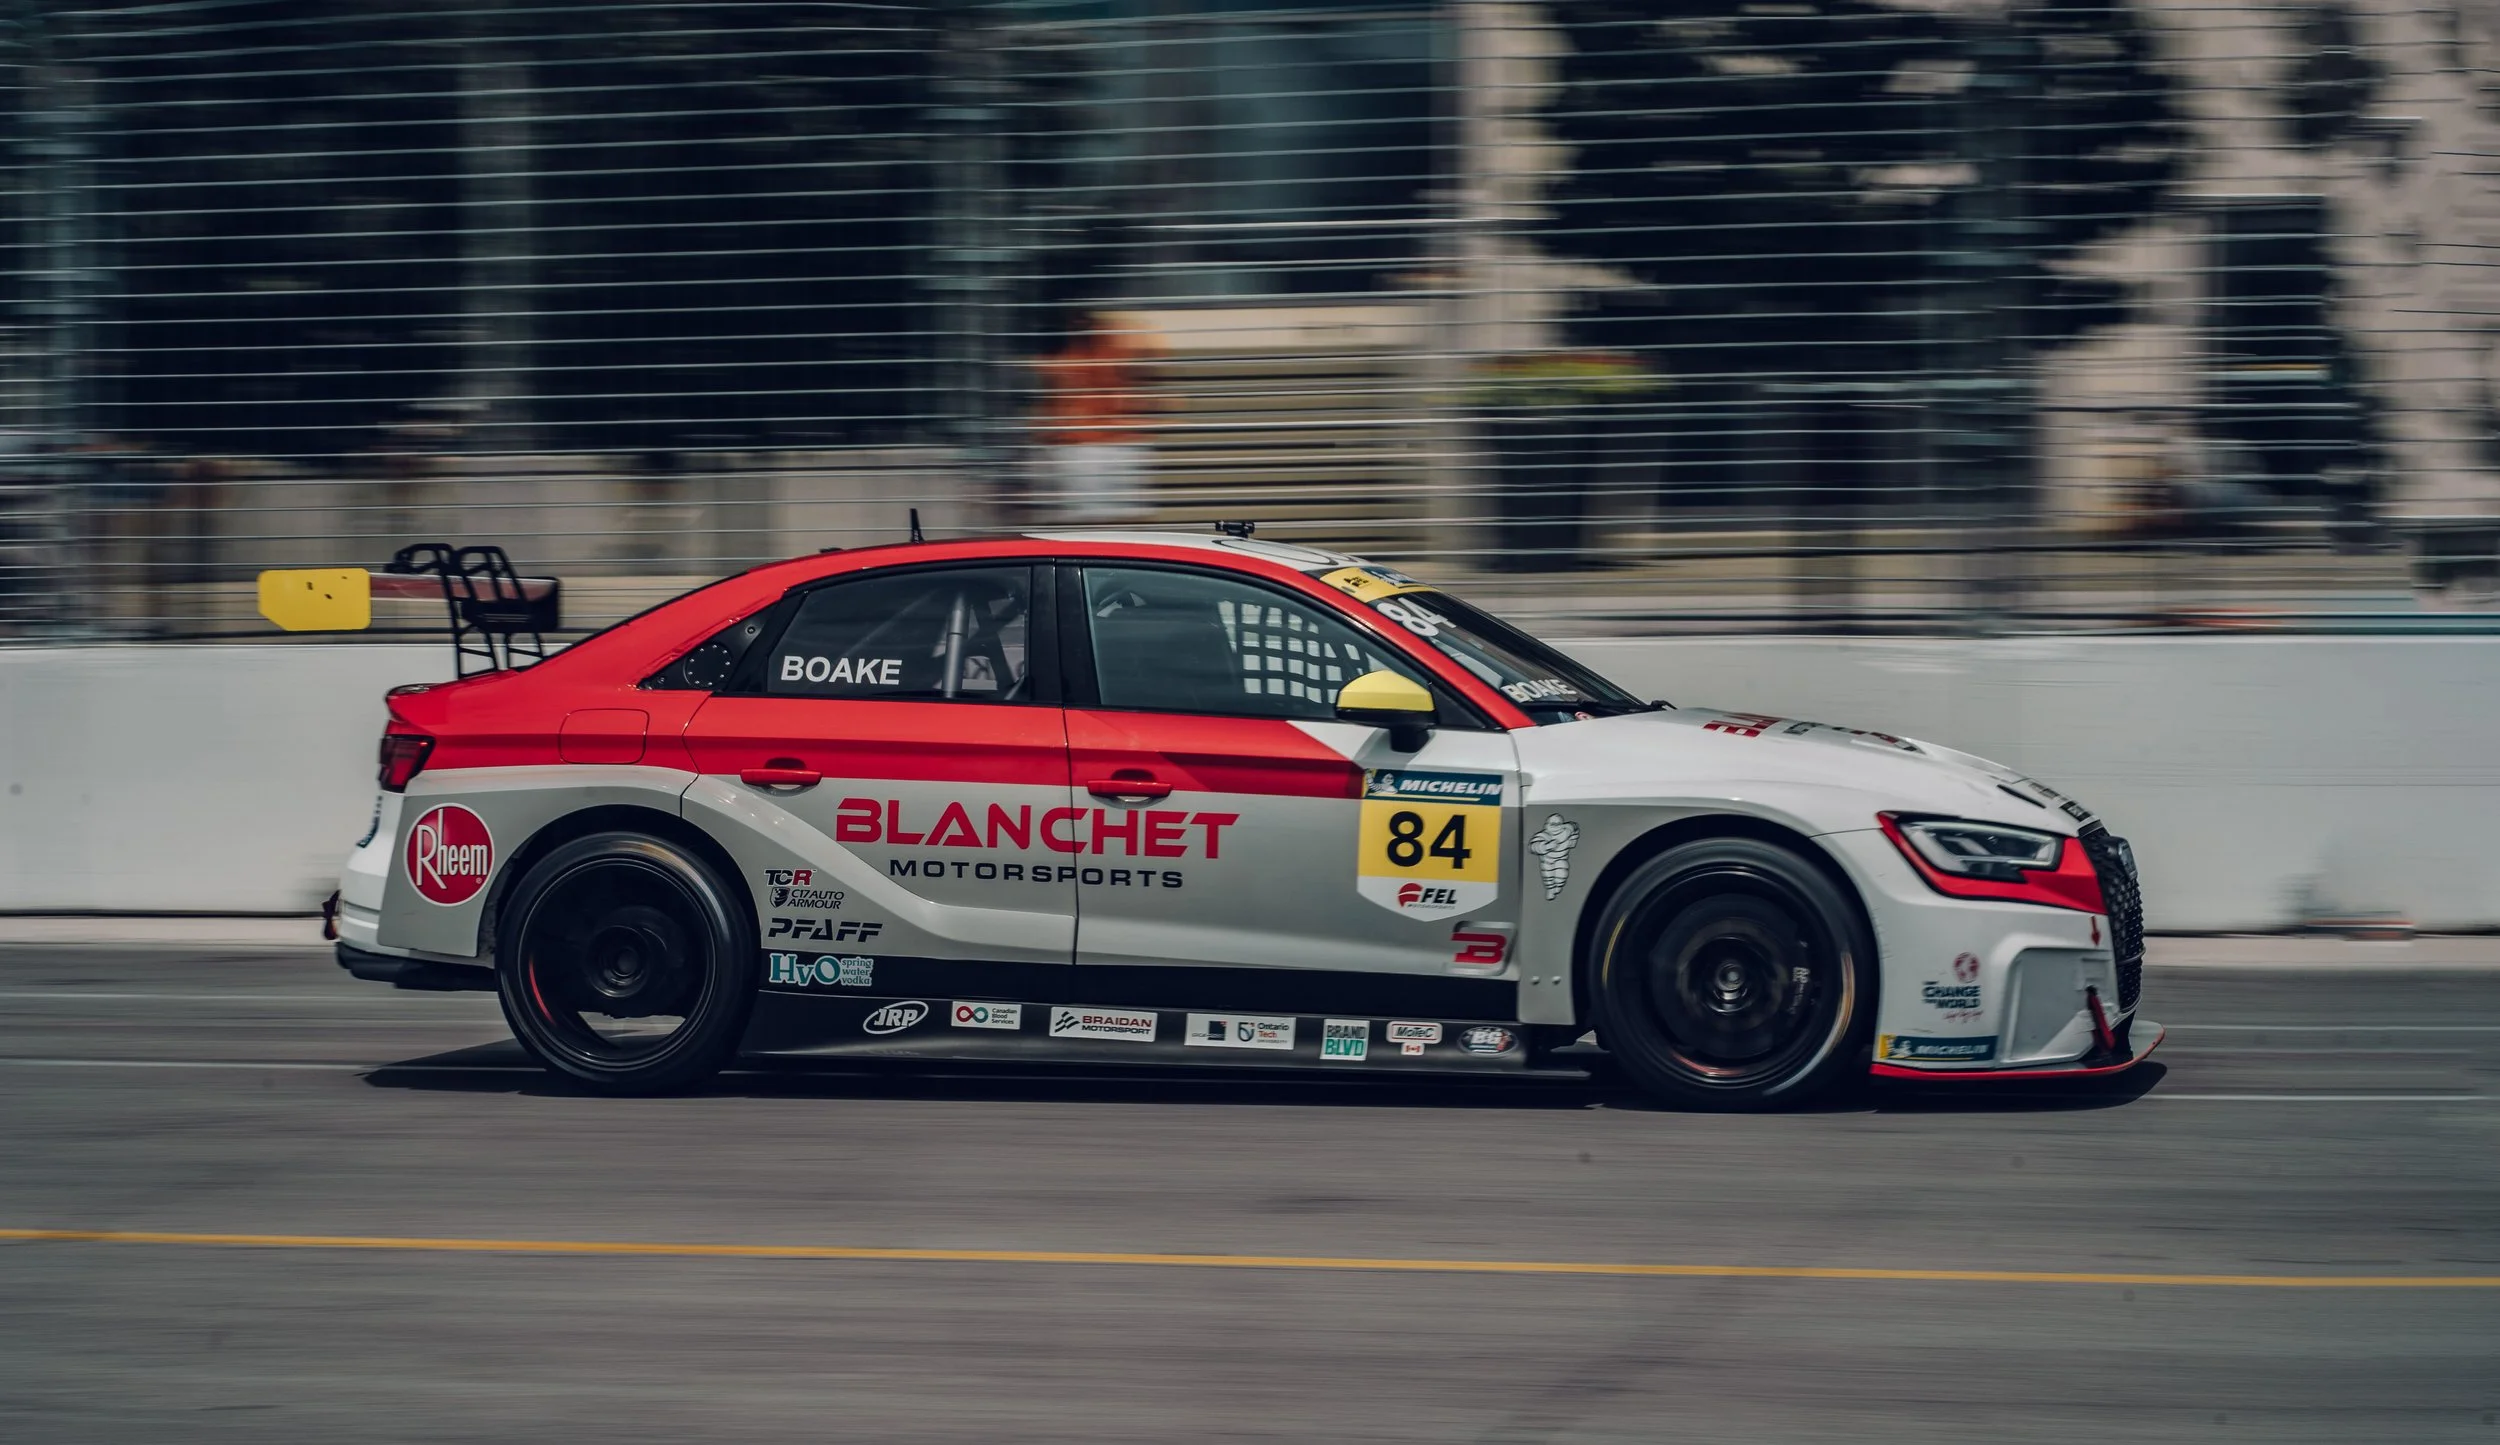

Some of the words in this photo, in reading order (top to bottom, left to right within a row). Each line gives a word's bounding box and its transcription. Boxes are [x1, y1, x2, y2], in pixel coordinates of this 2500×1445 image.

[1376, 597, 1457, 637] 84
[781, 655, 902, 685] BOAKE
[1500, 679, 1577, 703] BOAKE
[1400, 778, 1503, 795] MICHELIN
[836, 798, 1240, 859] BLANCHET
[416, 808, 488, 889] Rheem
[1386, 811, 1472, 869] 84
[765, 869, 813, 886] TCR
[889, 859, 1183, 888] MOTORSPORTS
[787, 899, 841, 909] ARMOUR
[1421, 887, 1457, 904] FEL
[768, 918, 883, 943] PFAFF
[841, 957, 872, 968] spring
[841, 975, 870, 985] vodka
[842, 968, 870, 976] water
[1923, 985, 1981, 998] CHANGE
[874, 1008, 918, 1027] JRP
[1082, 1015, 1152, 1028] BRAIDAN
[1081, 1025, 1151, 1035] MOTORSPORT
[1257, 1022, 1289, 1031] Ontario
[1326, 1024, 1367, 1039] BRAND
[1395, 1026, 1434, 1038] MoTeC
[1325, 1038, 1365, 1056] BLVD
[1914, 1045, 1990, 1055] MICHELIN
